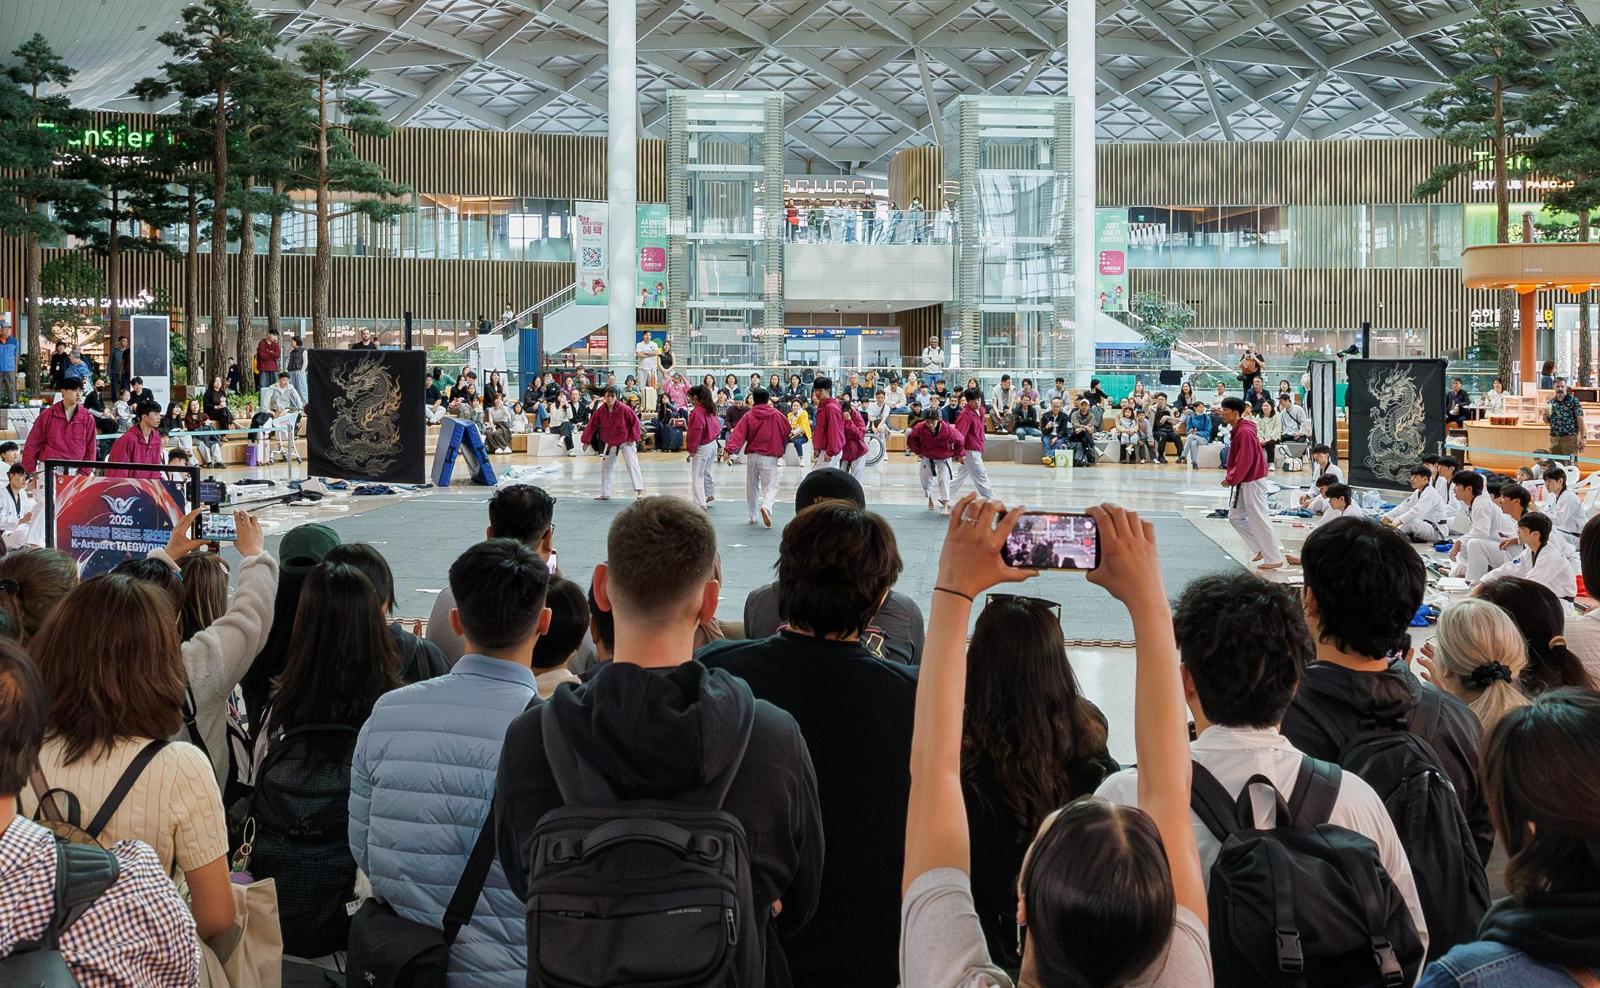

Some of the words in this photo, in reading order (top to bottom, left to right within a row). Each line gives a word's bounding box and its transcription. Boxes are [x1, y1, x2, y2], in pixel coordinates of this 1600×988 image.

[37, 122, 155, 148] nsfer
[753, 181, 874, 193] SCUCCI
[109, 515, 133, 525] 2025
